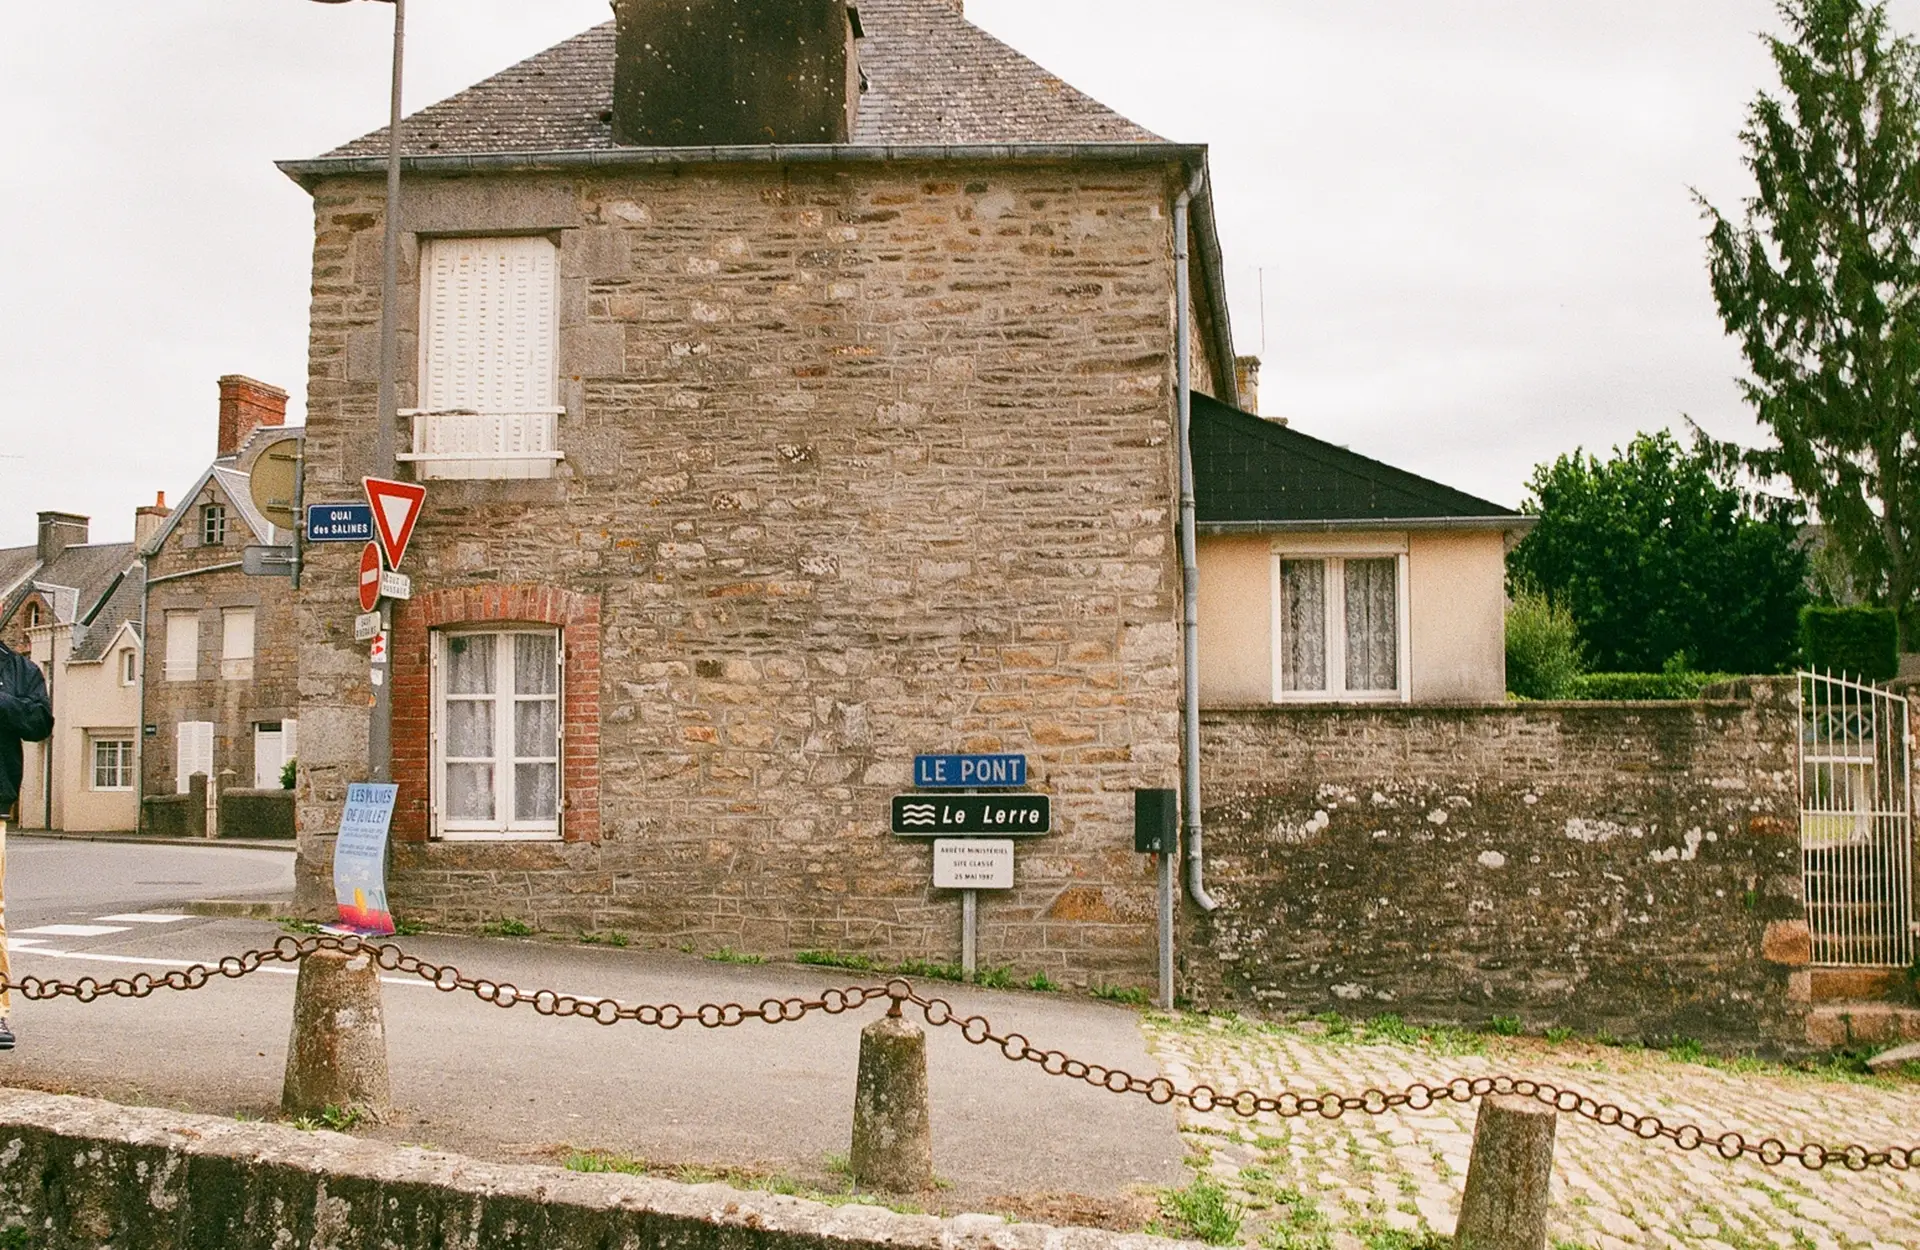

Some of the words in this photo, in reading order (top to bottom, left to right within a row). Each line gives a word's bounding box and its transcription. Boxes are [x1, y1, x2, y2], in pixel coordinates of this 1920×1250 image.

[331, 511, 352, 521] QUAI
[313, 524, 329, 534] des
[331, 523, 368, 534] SALINES
[921, 759, 947, 782] LE
[961, 759, 1021, 782] PONT
[350, 788, 365, 803] LES
[365, 788, 393, 804] PLUIES
[346, 807, 358, 822] DE
[357, 808, 388, 825] JUILLET
[942, 805, 966, 824] Le
[983, 805, 1040, 824] Lerre
[969, 859, 994, 867] CLASSÉ
